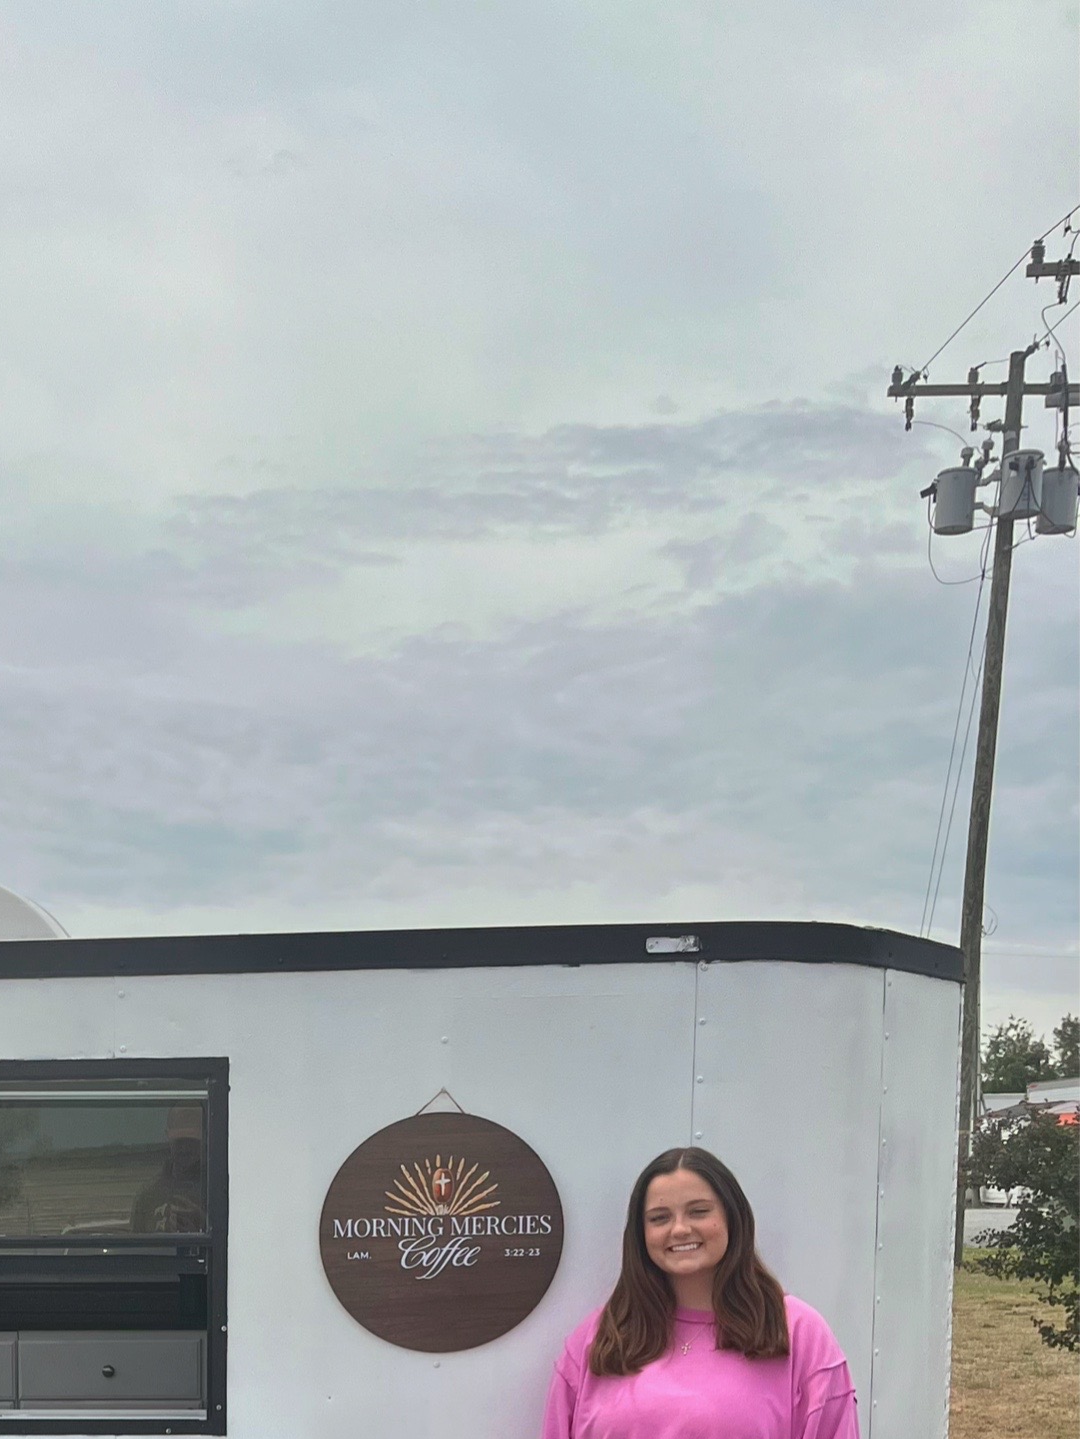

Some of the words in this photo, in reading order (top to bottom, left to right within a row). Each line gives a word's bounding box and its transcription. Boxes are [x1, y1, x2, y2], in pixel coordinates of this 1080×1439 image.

[333, 1217, 444, 1238] MORNING
[450, 1215, 552, 1236] MERCIES
[347, 1251, 372, 1260] LAM.
[398, 1234, 482, 1280] Coffee
[504, 1248, 541, 1257] 3:22-23
